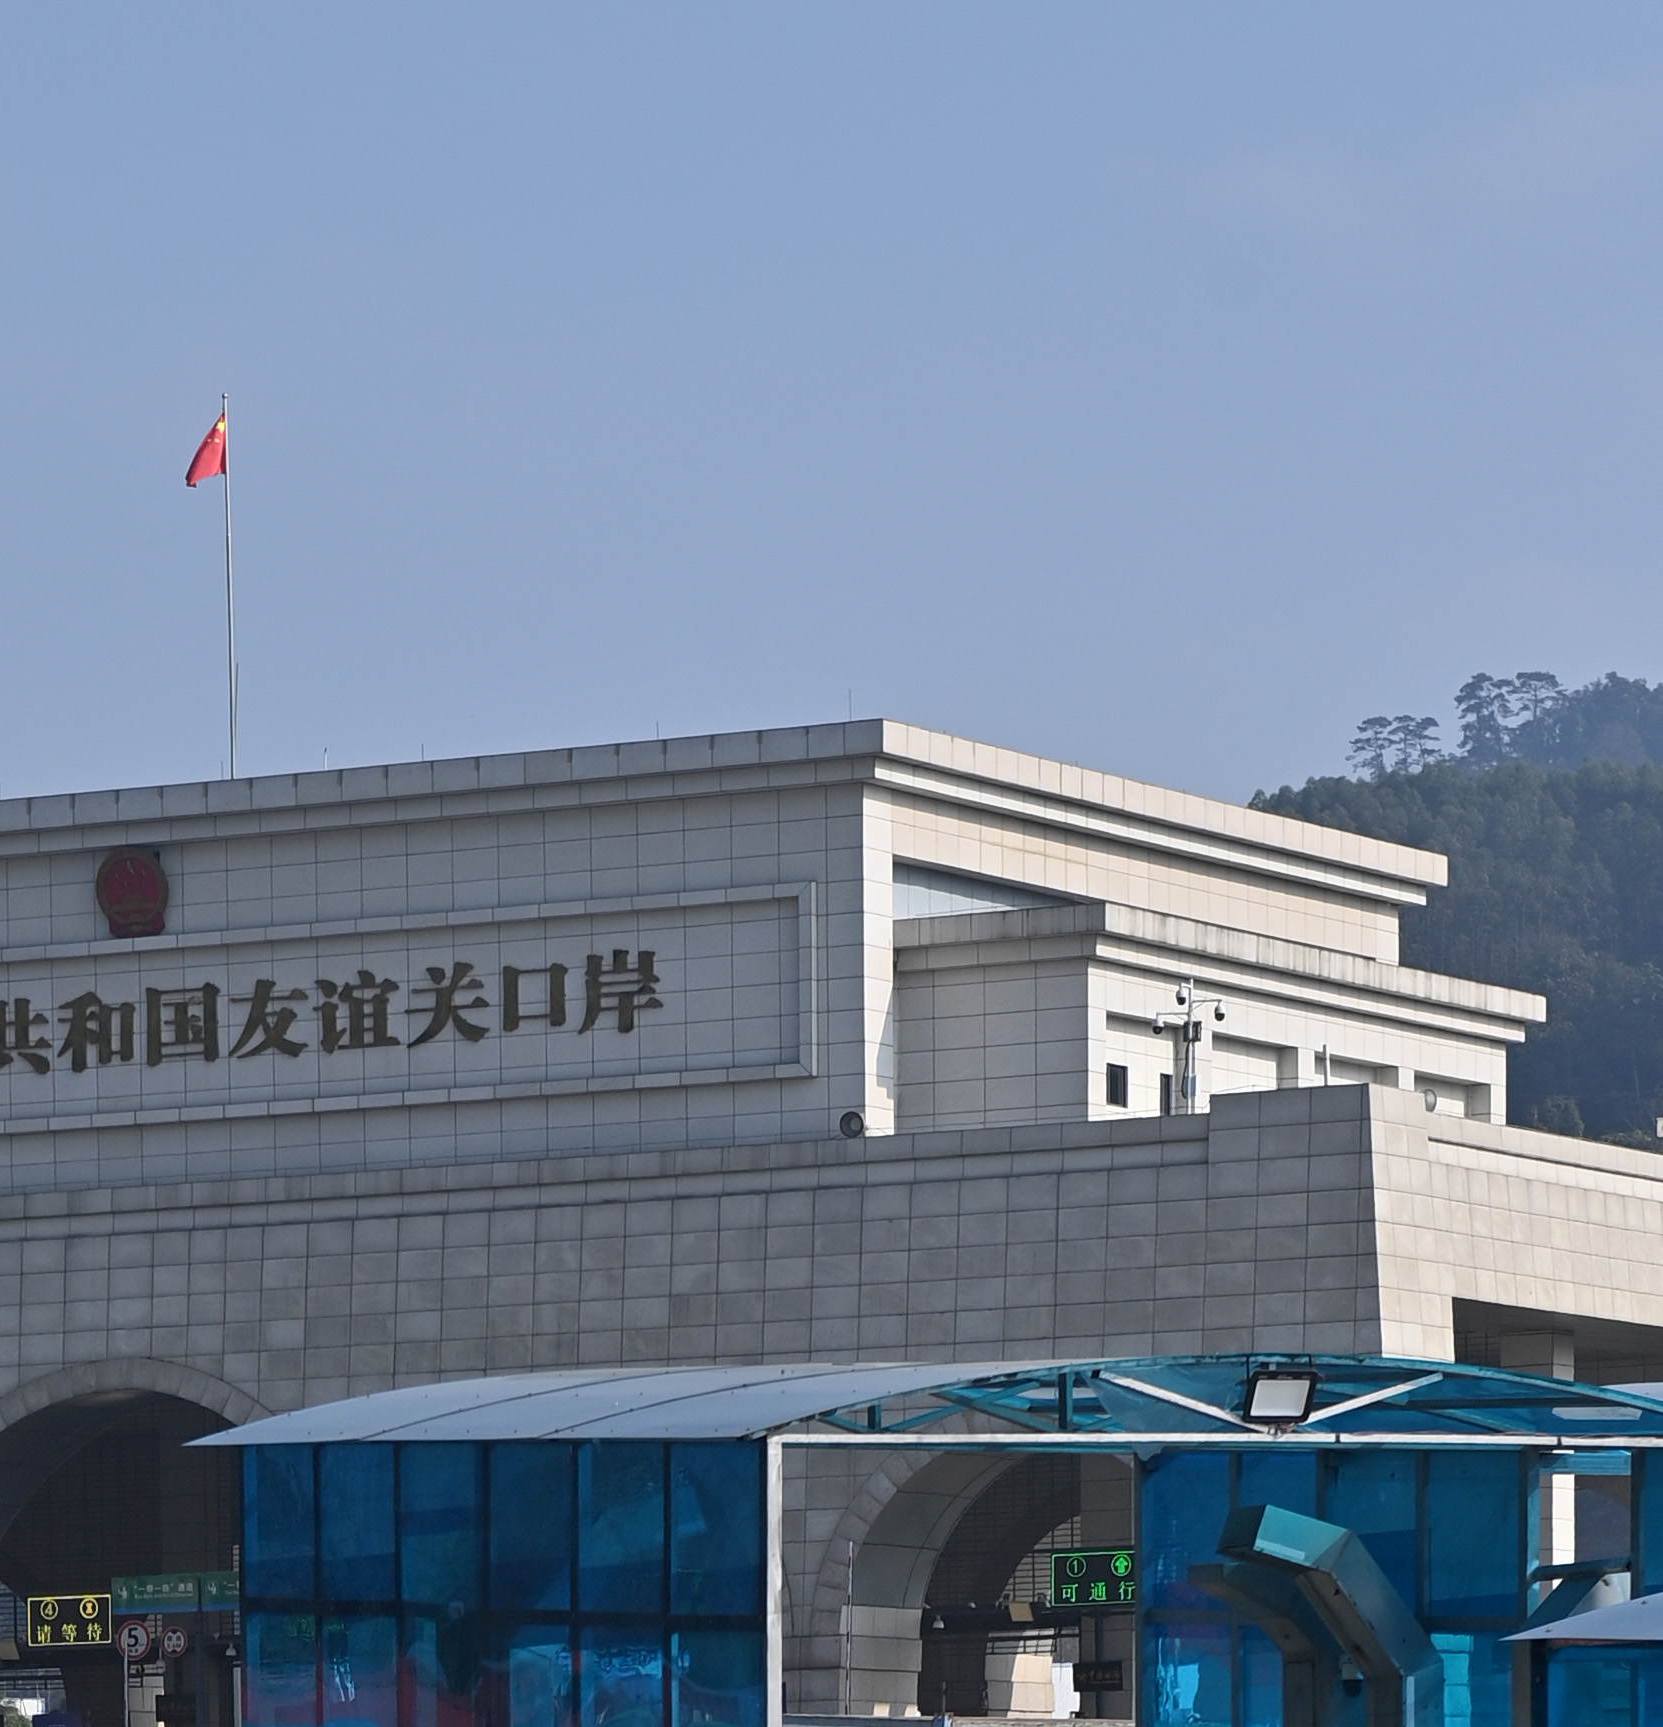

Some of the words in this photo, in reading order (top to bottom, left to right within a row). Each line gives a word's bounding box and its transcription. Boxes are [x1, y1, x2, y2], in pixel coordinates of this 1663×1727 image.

[1060, 1581, 1135, 1603] 可通行
[37, 1622, 102, 1644] 请等待
[127, 1627, 139, 1647] 5
